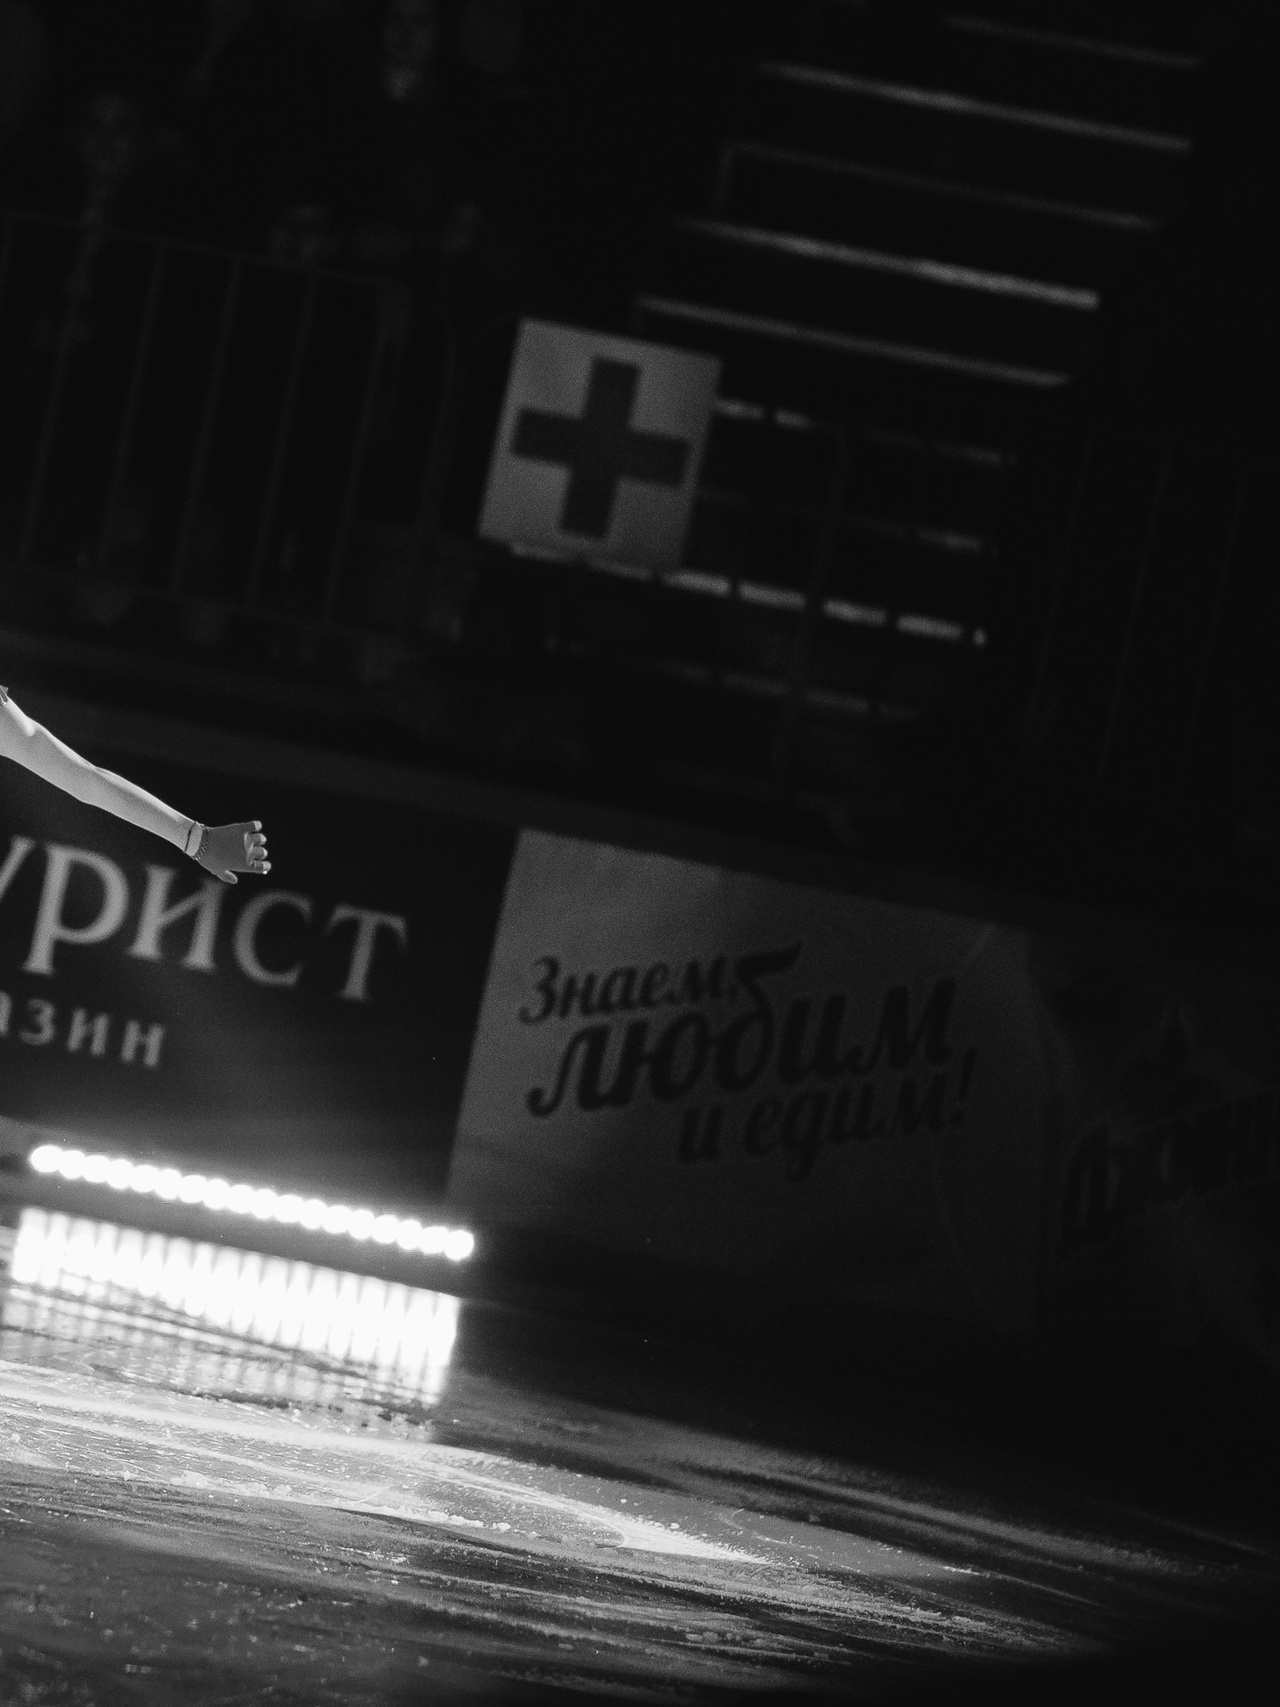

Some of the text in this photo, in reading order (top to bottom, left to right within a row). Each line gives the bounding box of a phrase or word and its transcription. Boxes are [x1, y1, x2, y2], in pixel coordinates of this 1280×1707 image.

[526, 941, 957, 1118] любим
[677, 1047, 977, 1182] и едим!
